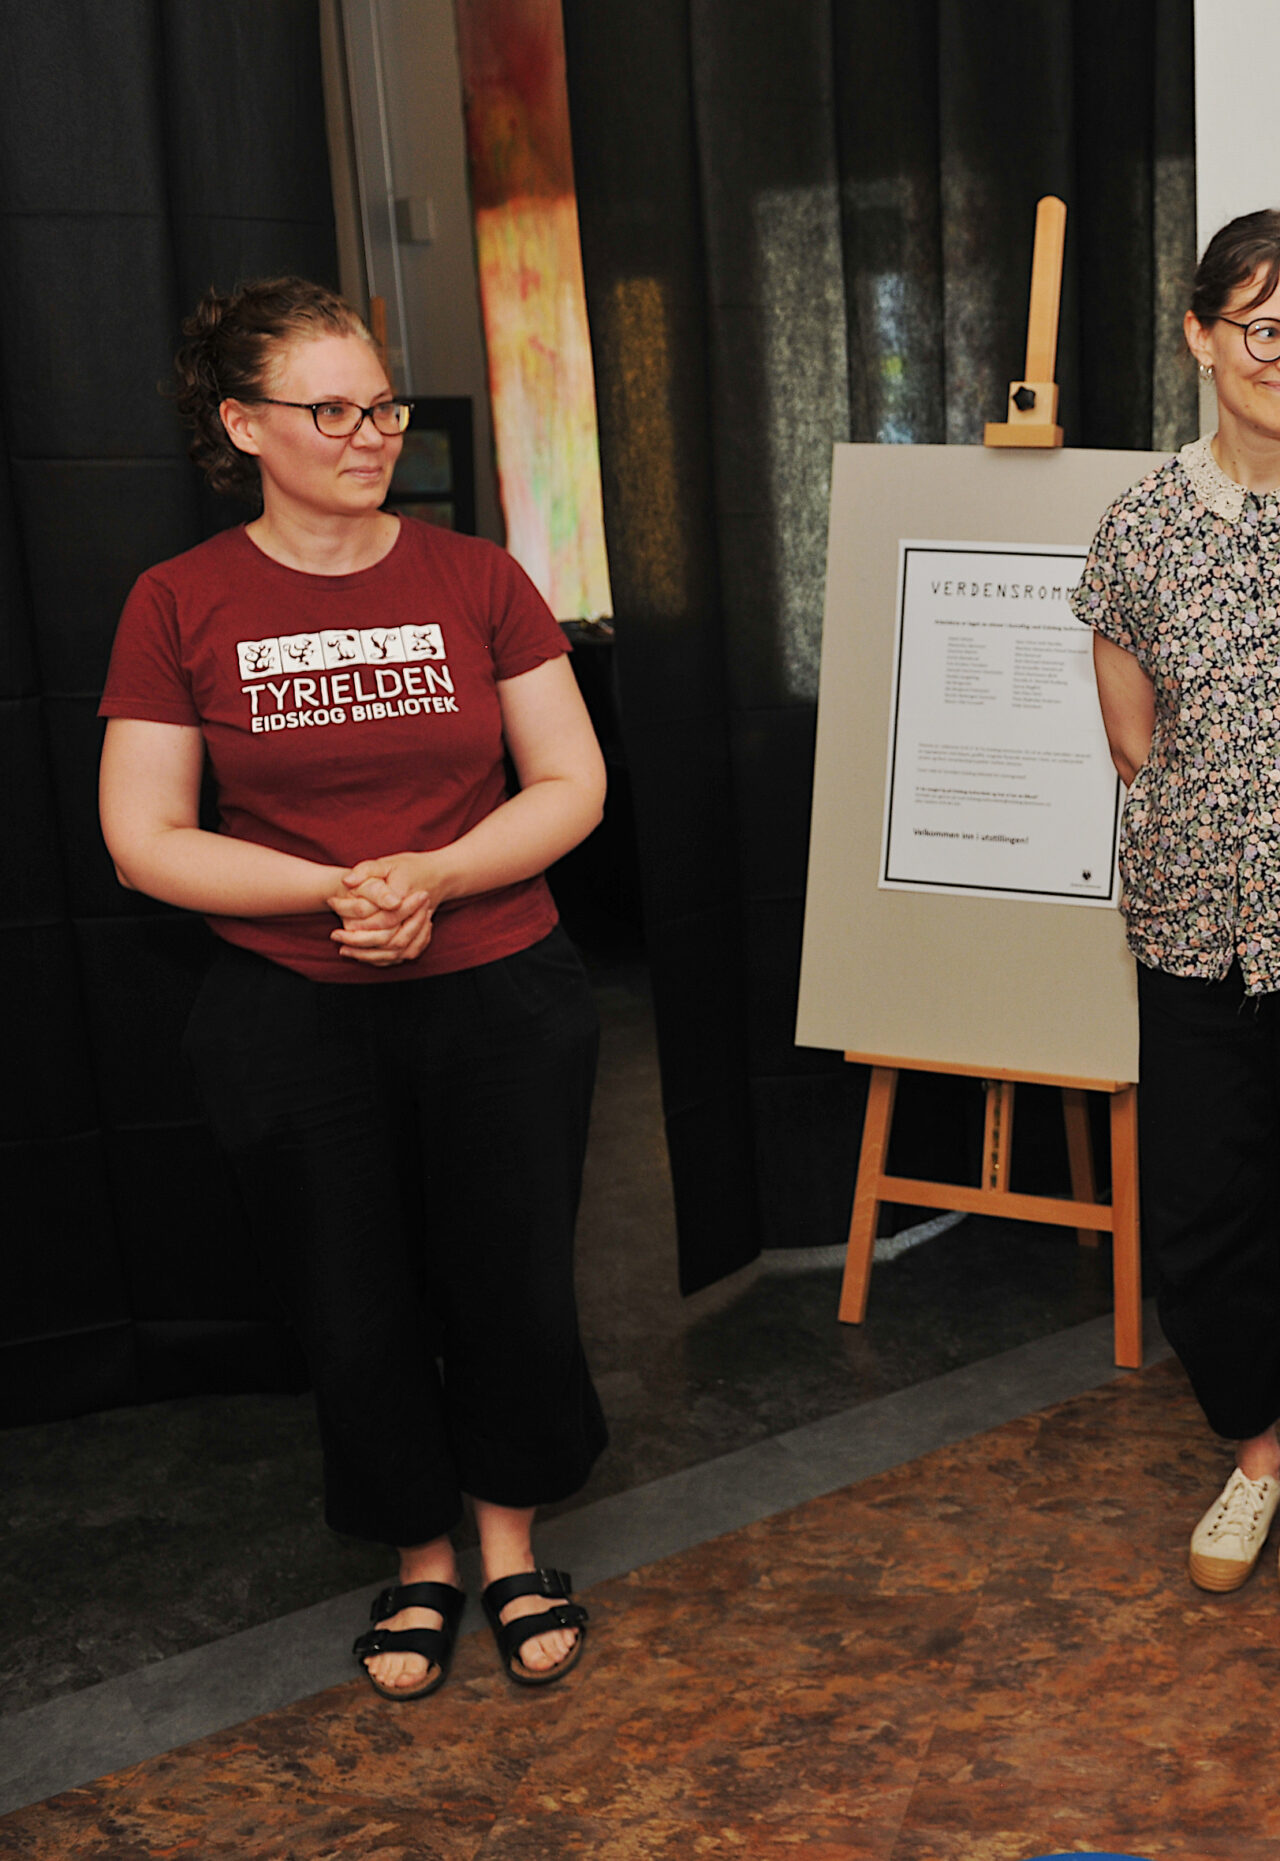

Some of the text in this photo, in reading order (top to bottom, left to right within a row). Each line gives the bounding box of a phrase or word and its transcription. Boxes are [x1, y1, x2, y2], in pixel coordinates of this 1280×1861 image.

[931, 581, 1078, 600] VERDENSROMM
[241, 665, 455, 715] TYRIELDEN
[251, 696, 460, 733] EIDSKOG BIBLIOTEK
[913, 827, 959, 838] Velkommen
